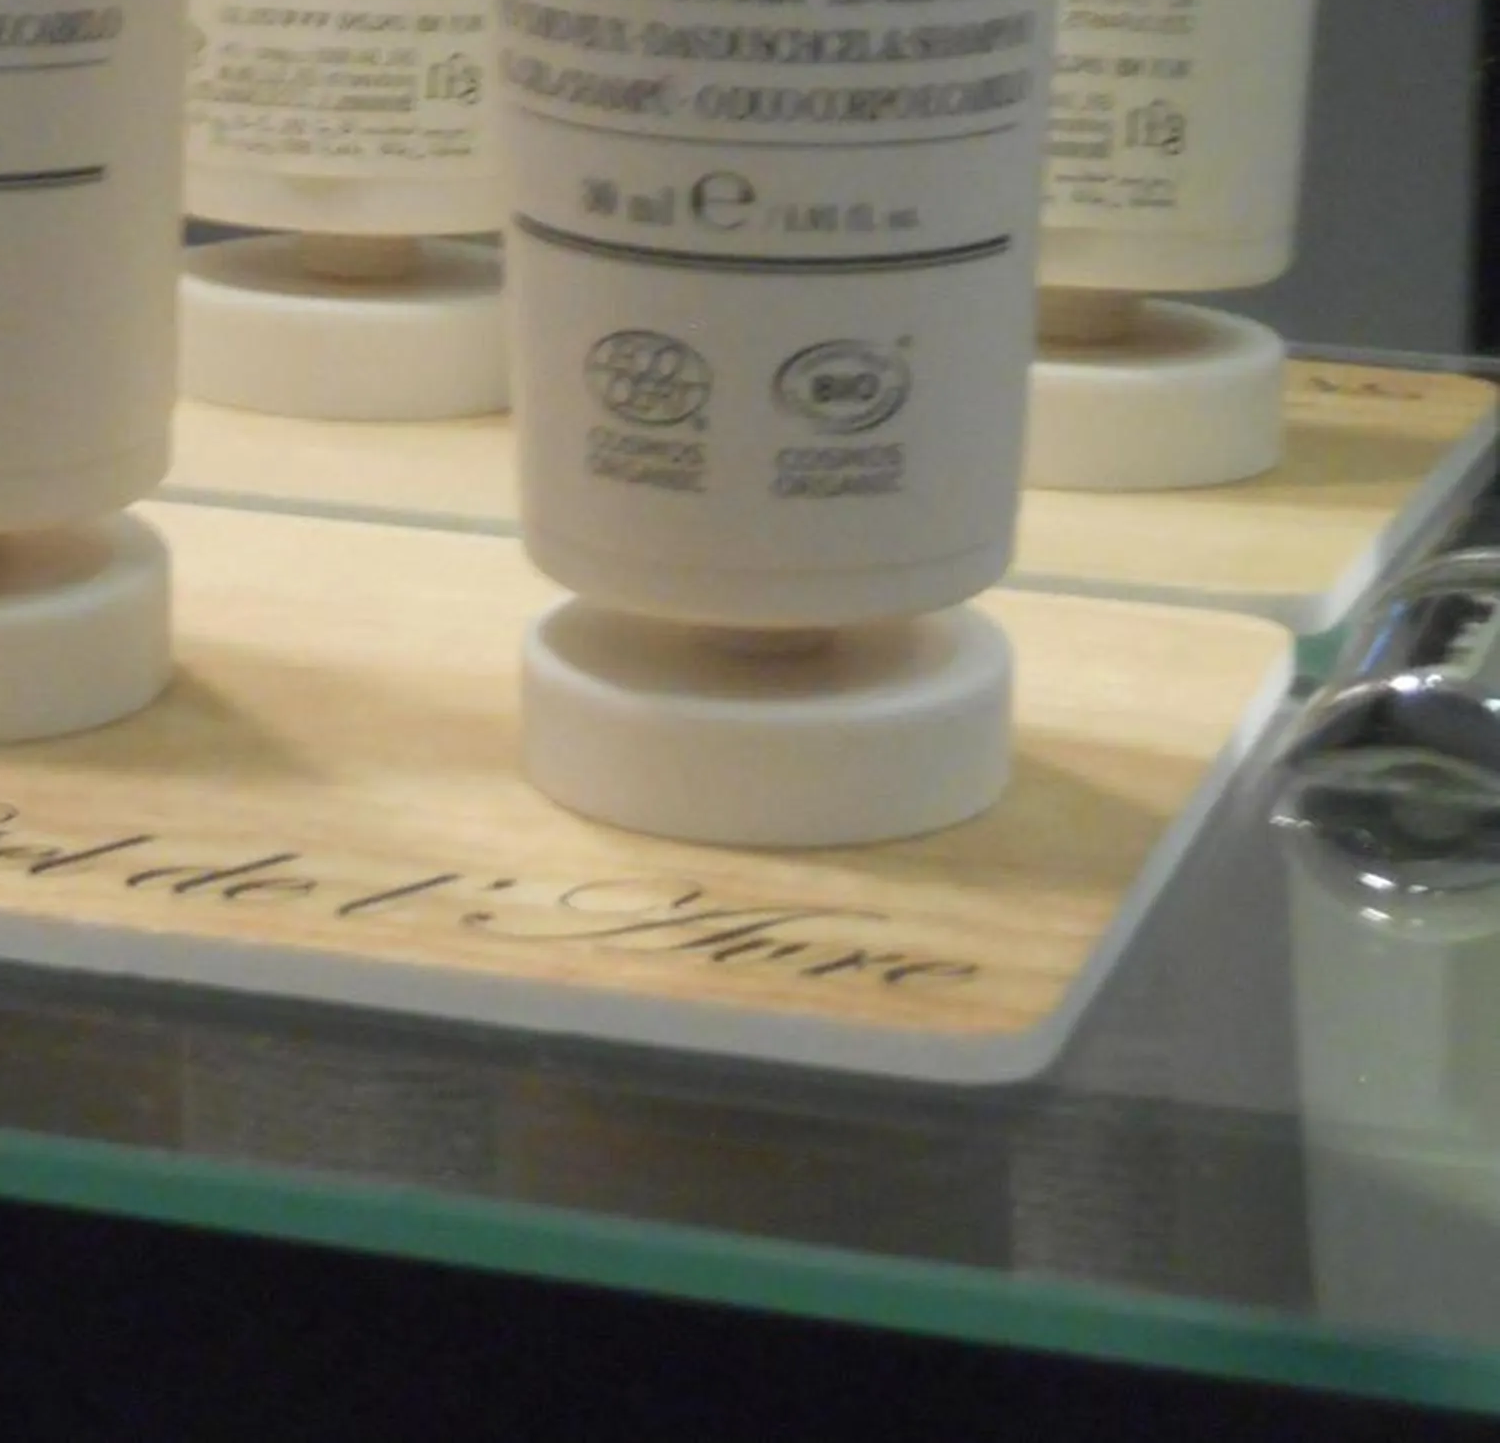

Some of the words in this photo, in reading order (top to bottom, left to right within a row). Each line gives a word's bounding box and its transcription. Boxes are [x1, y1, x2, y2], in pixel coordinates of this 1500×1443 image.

[811, 372, 882, 406] BIO
[773, 443, 906, 472] COSMOS
[125, 852, 319, 900] de
